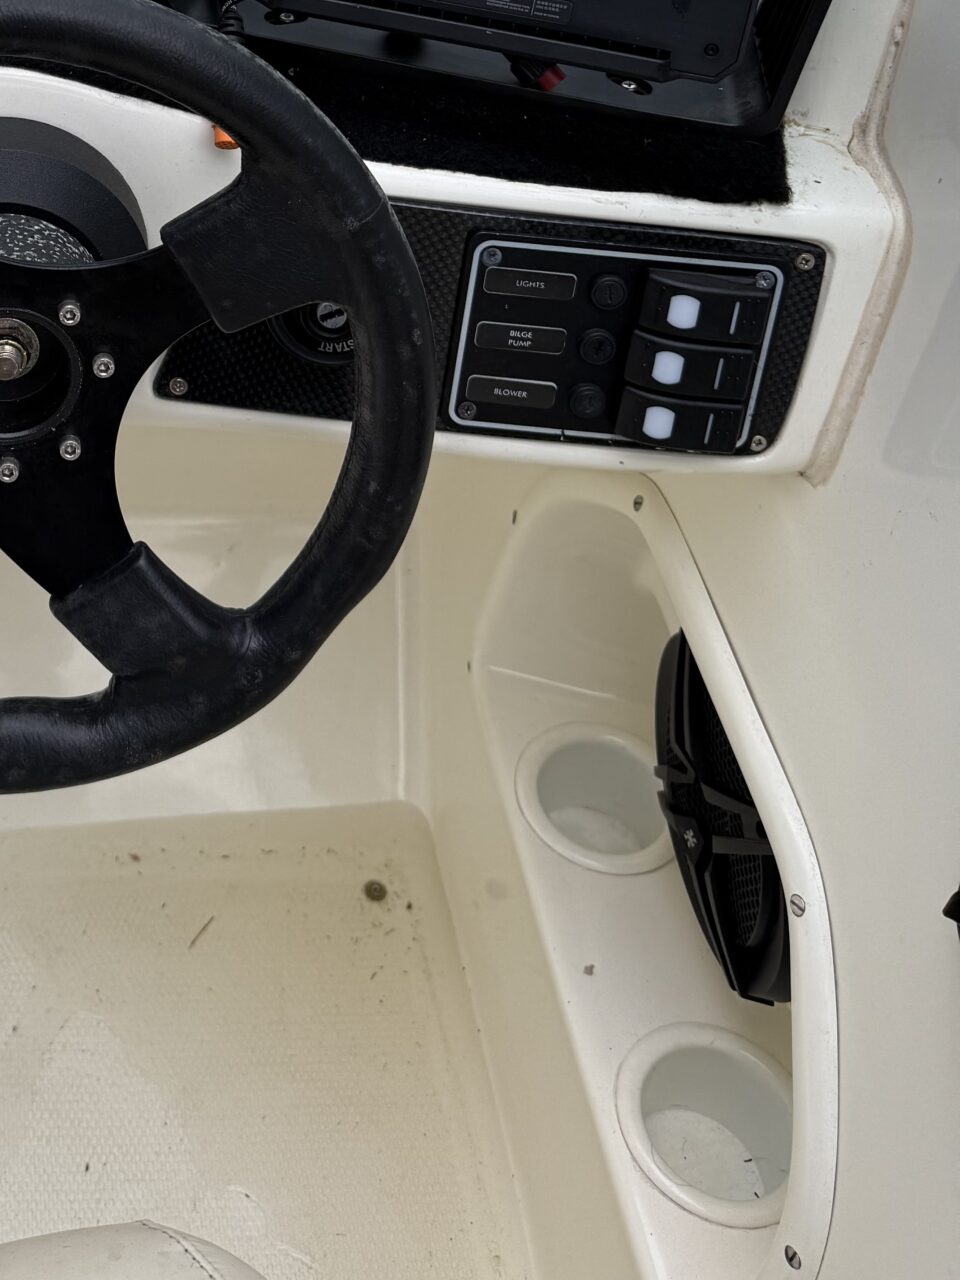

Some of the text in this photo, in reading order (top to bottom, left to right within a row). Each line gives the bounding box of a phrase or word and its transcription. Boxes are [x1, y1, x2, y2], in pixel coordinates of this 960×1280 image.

[515, 279, 545, 289] LIGHTS
[509, 329, 533, 339] BILGE
[317, 339, 354, 352] START
[508, 339, 532, 348] PUMP
[493, 387, 528, 398] BLOWER
